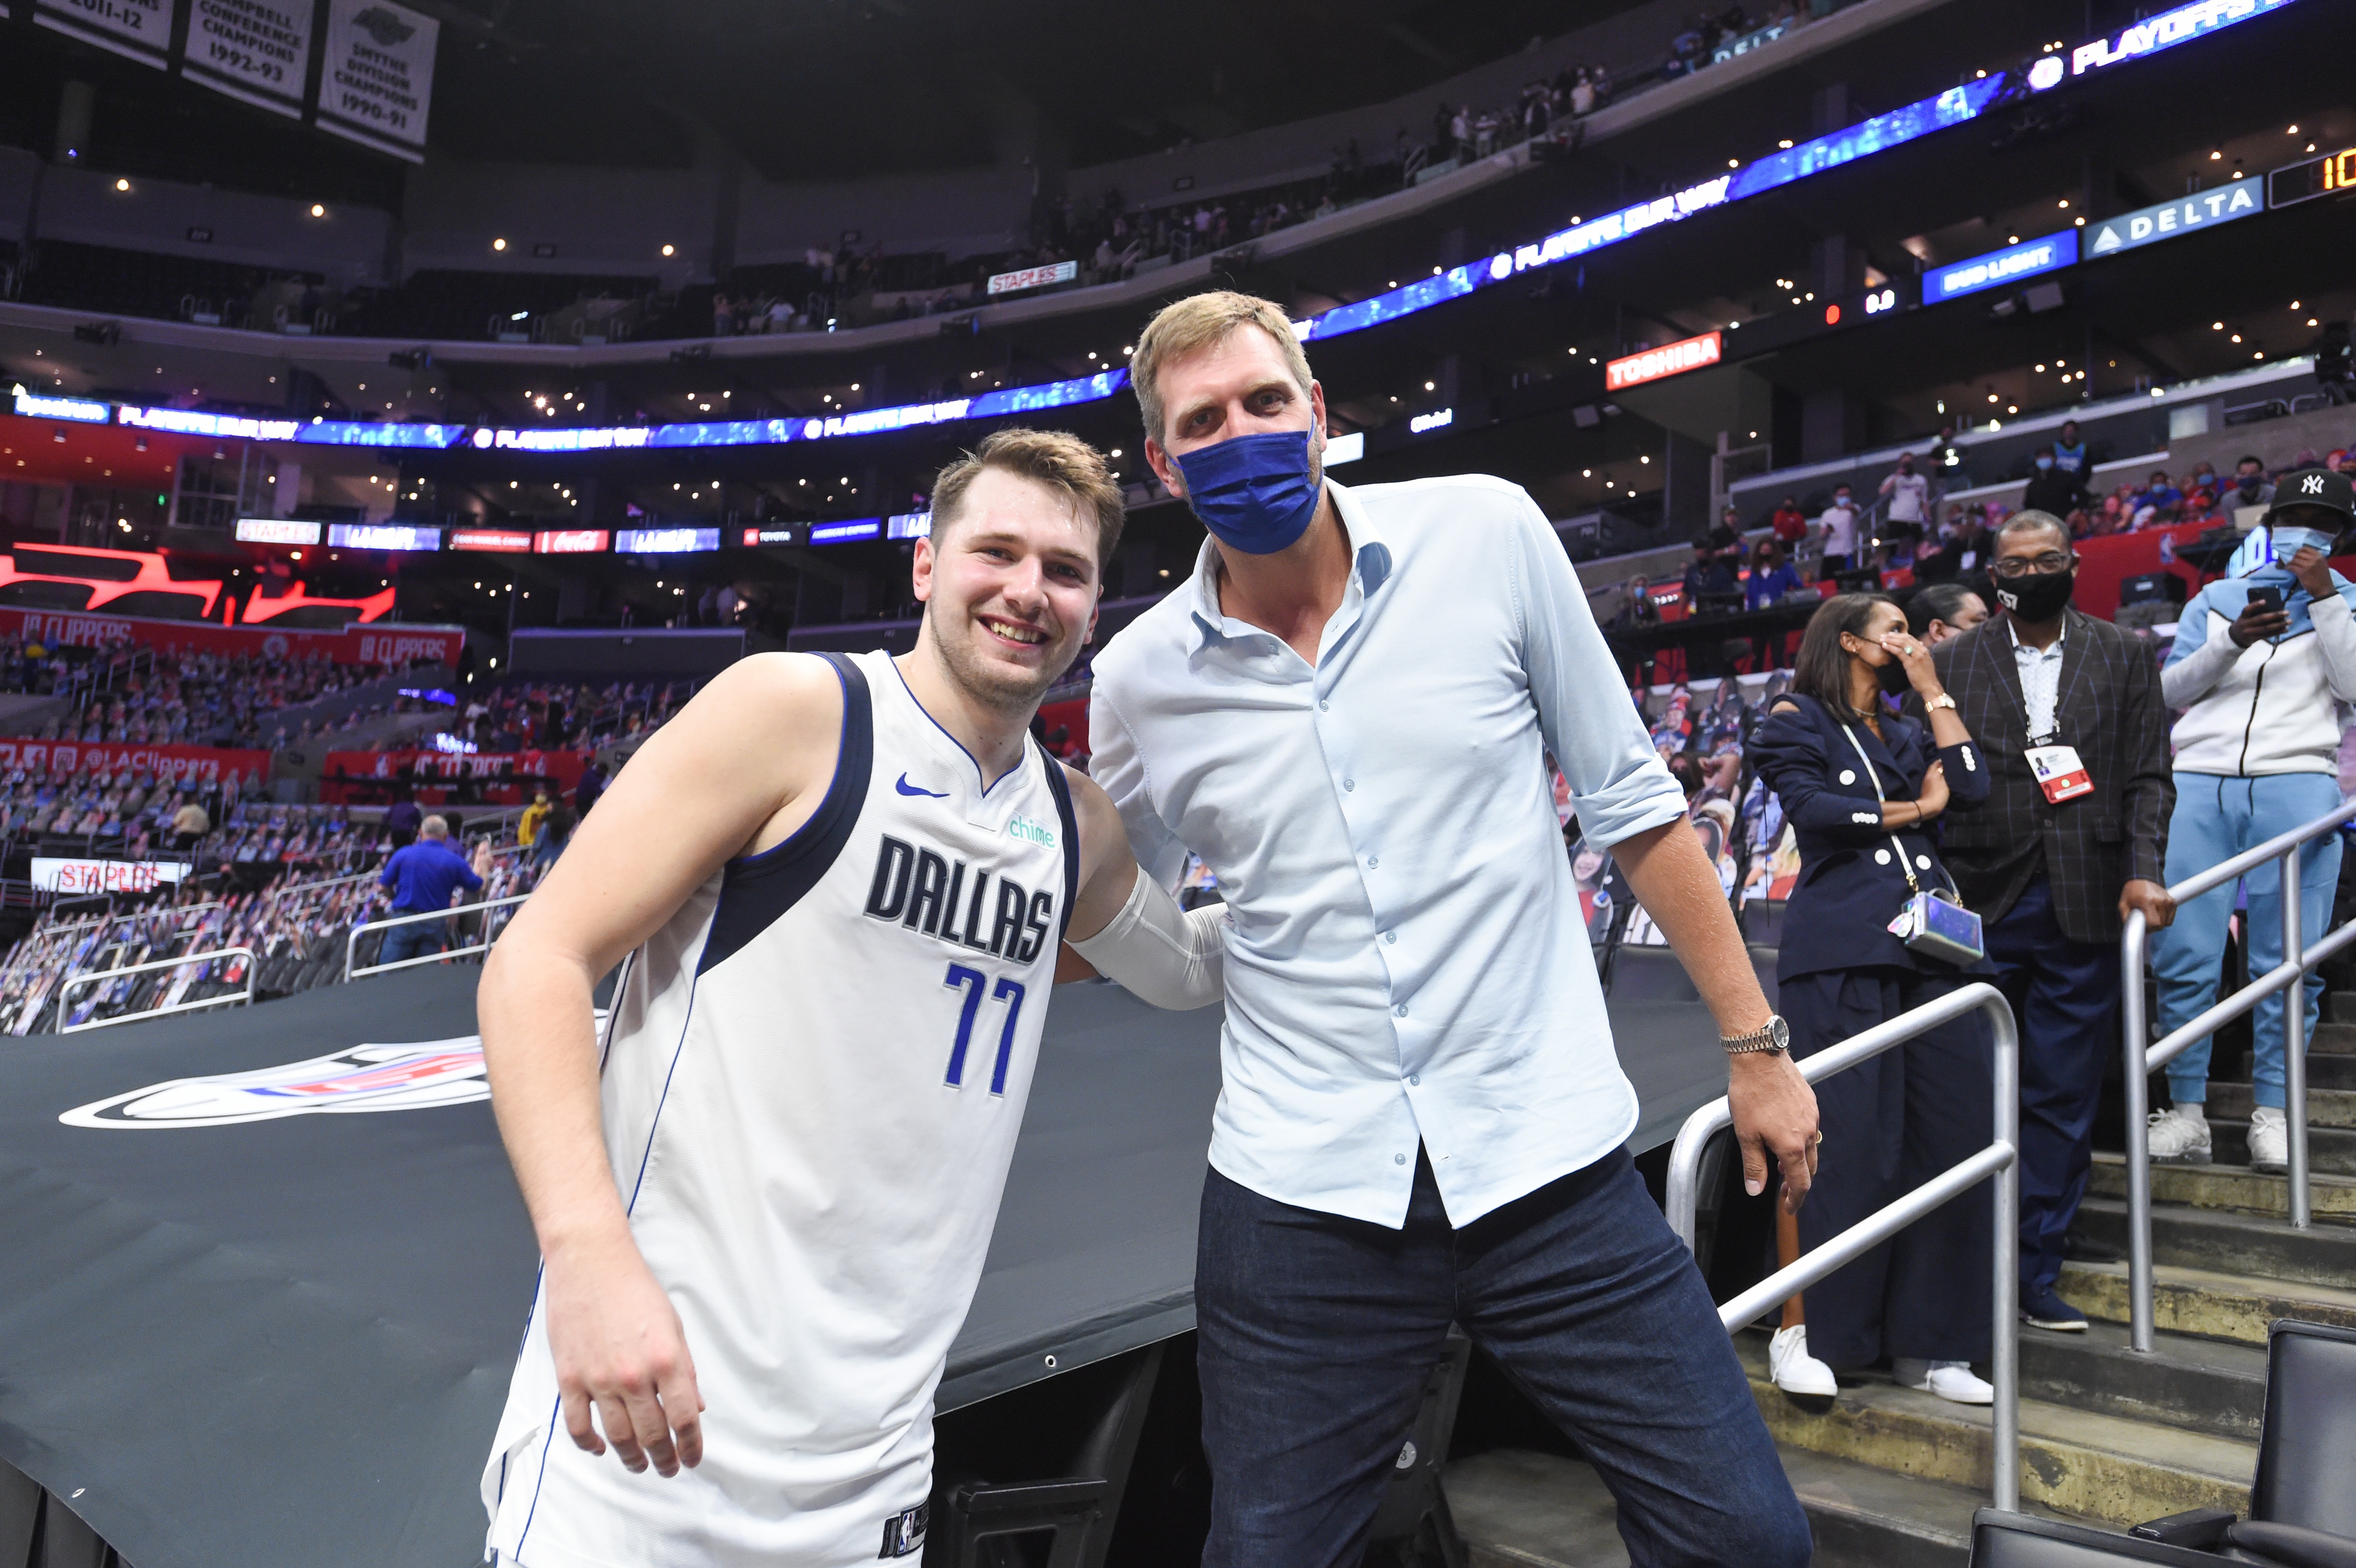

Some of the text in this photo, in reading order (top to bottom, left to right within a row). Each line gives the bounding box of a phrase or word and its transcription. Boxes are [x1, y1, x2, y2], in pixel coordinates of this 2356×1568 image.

[200, 0, 302, 48] CONFERENCE
[203, 18, 295, 63] CHAMPIONS
[210, 42, 283, 81] 1992-93
[347, 58, 411, 90] DIVISION
[353, 42, 408, 73] SMYTHE
[335, 70, 417, 110] CHAMPIONS
[342, 92, 406, 129] 1990-91
[2130, 188, 2254, 240] DELTA
[993, 266, 1056, 291] STAPLES
[1943, 246, 2052, 292] BUD LIGHT
[1608, 338, 1719, 385] TOSHIBA
[241, 522, 316, 541] STAPLES
[759, 531, 791, 542] TOYOTA
[1010, 816, 1055, 848] chime
[62, 864, 161, 893] STAPLES
[862, 833, 1053, 966] DALLAS
[942, 960, 1026, 1098] 77
